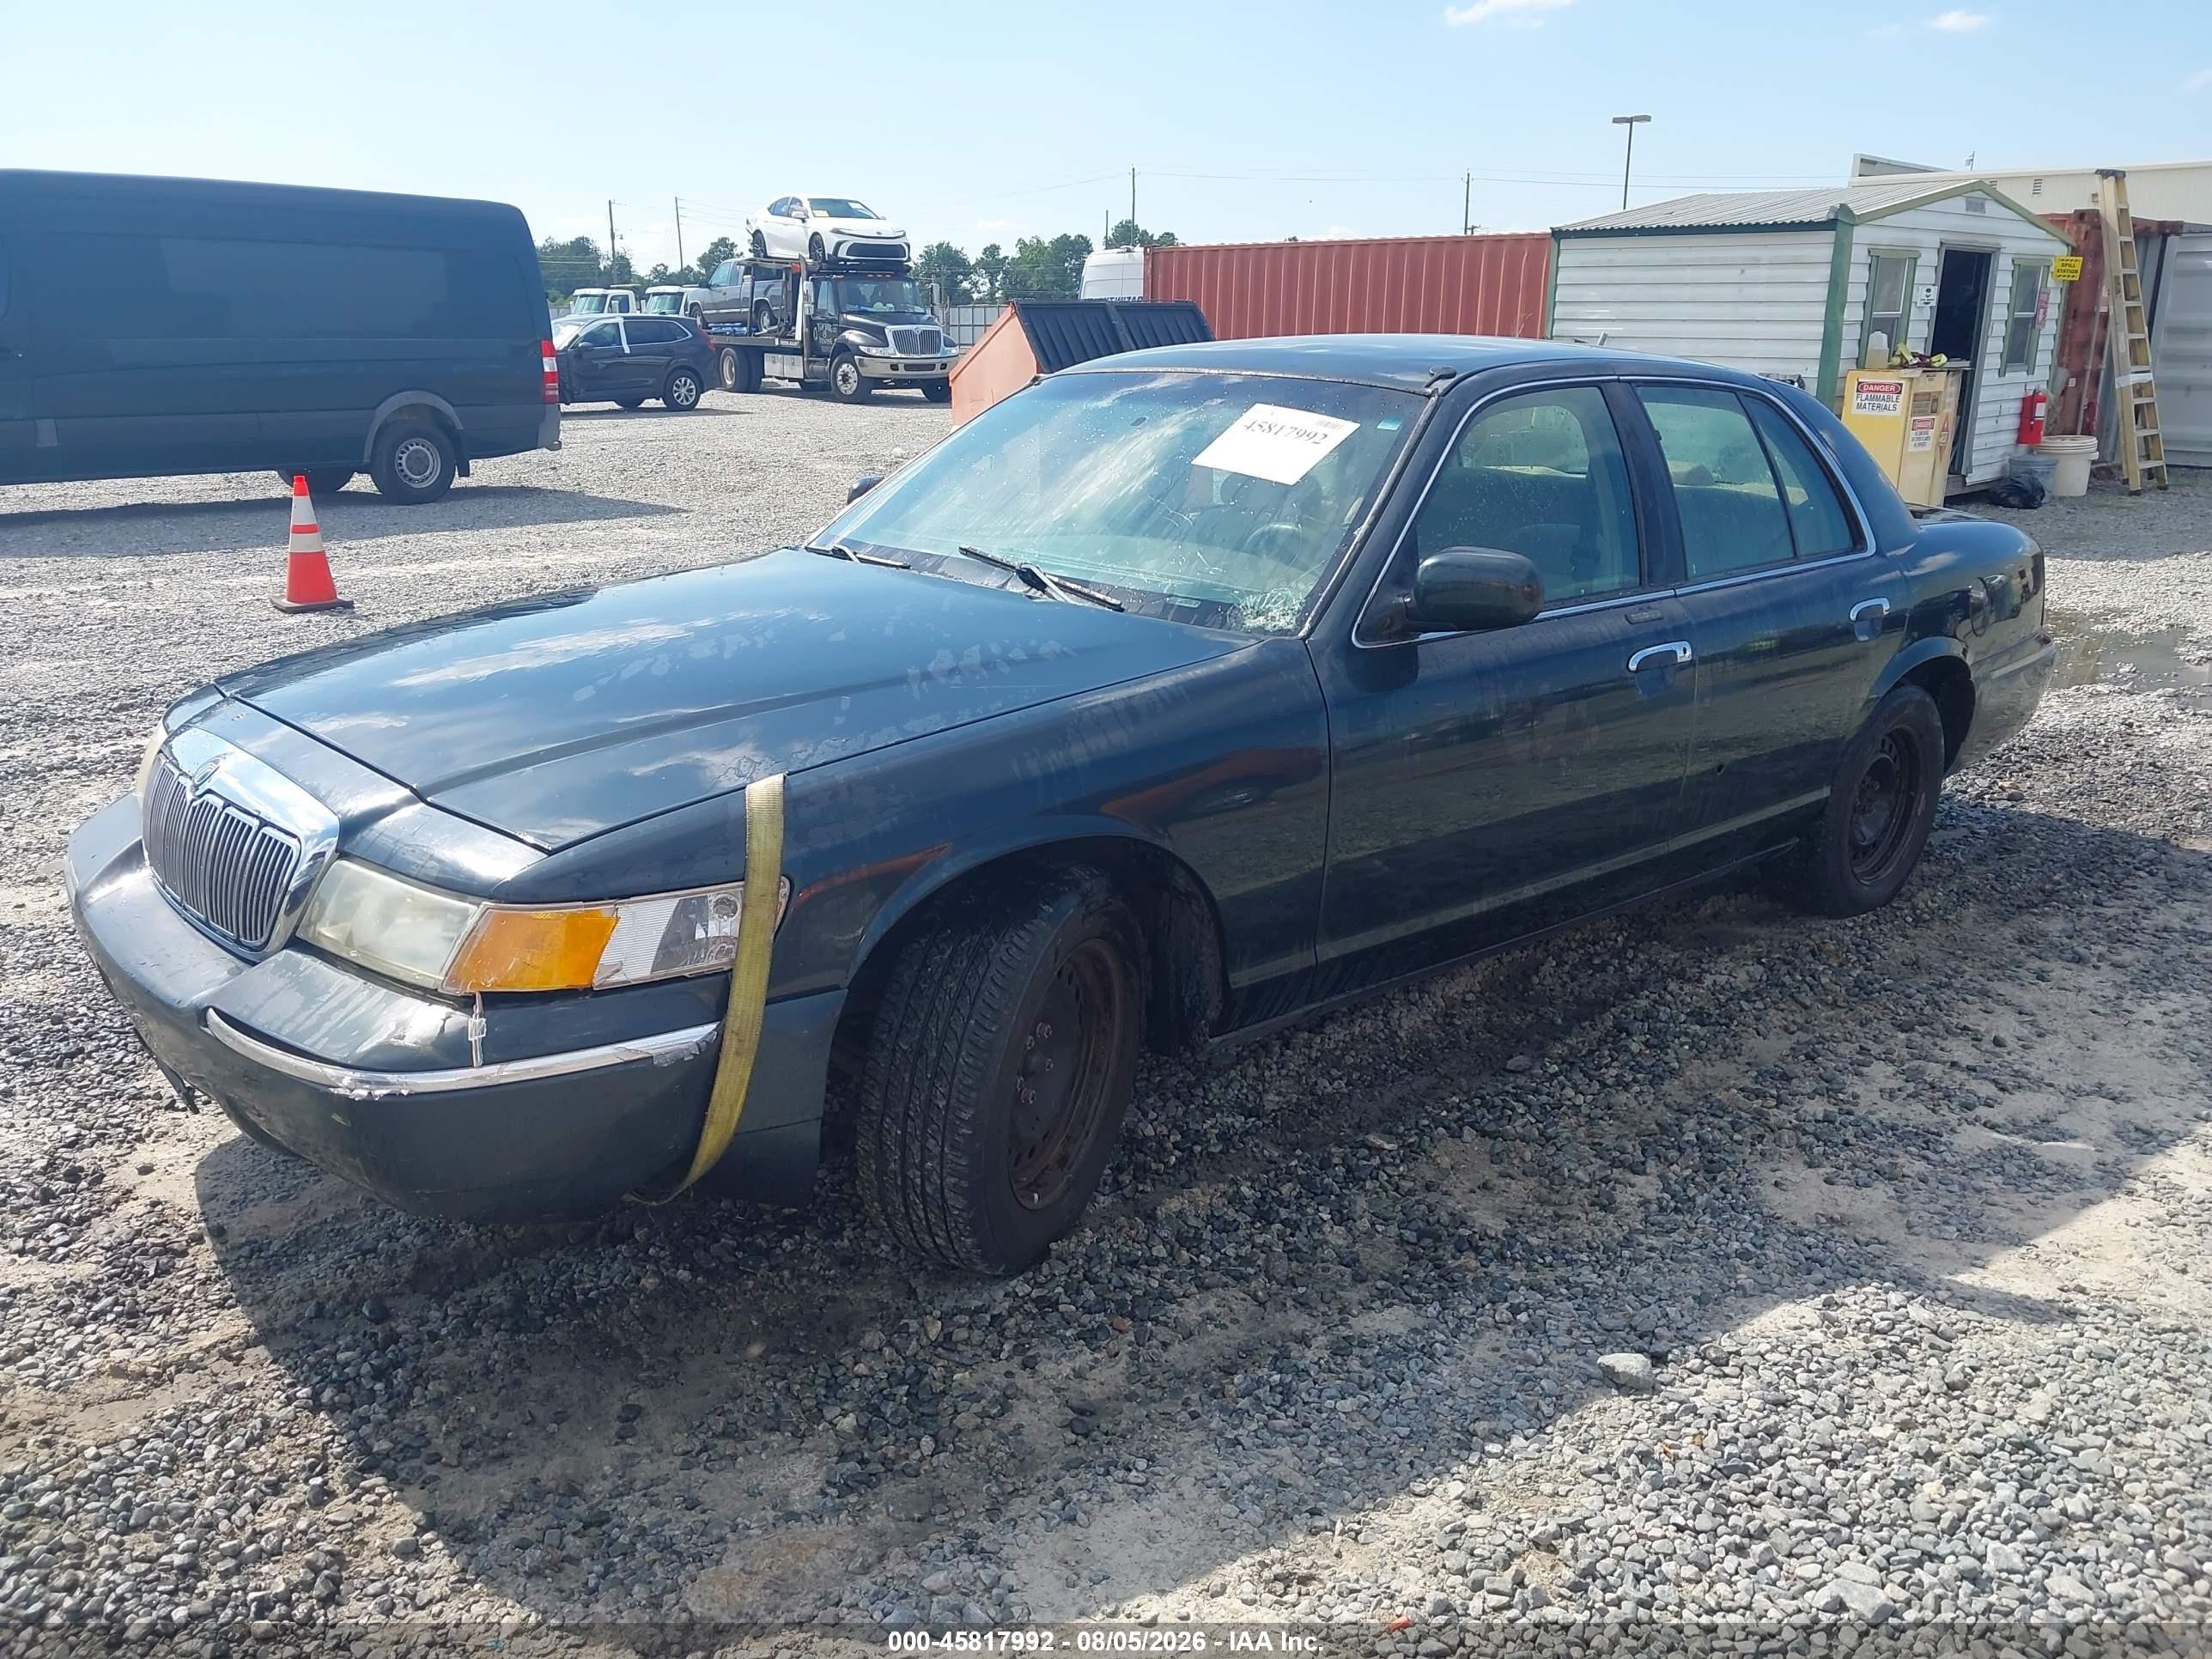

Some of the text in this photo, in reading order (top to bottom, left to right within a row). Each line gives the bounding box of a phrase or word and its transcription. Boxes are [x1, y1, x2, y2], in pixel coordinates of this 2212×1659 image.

[1863, 384, 1896, 392] DANGER
[1856, 393, 1900, 404] FLAMMABLE
[1856, 402, 1898, 412] MATERIALS
[1243, 420, 1328, 445] 45817992
